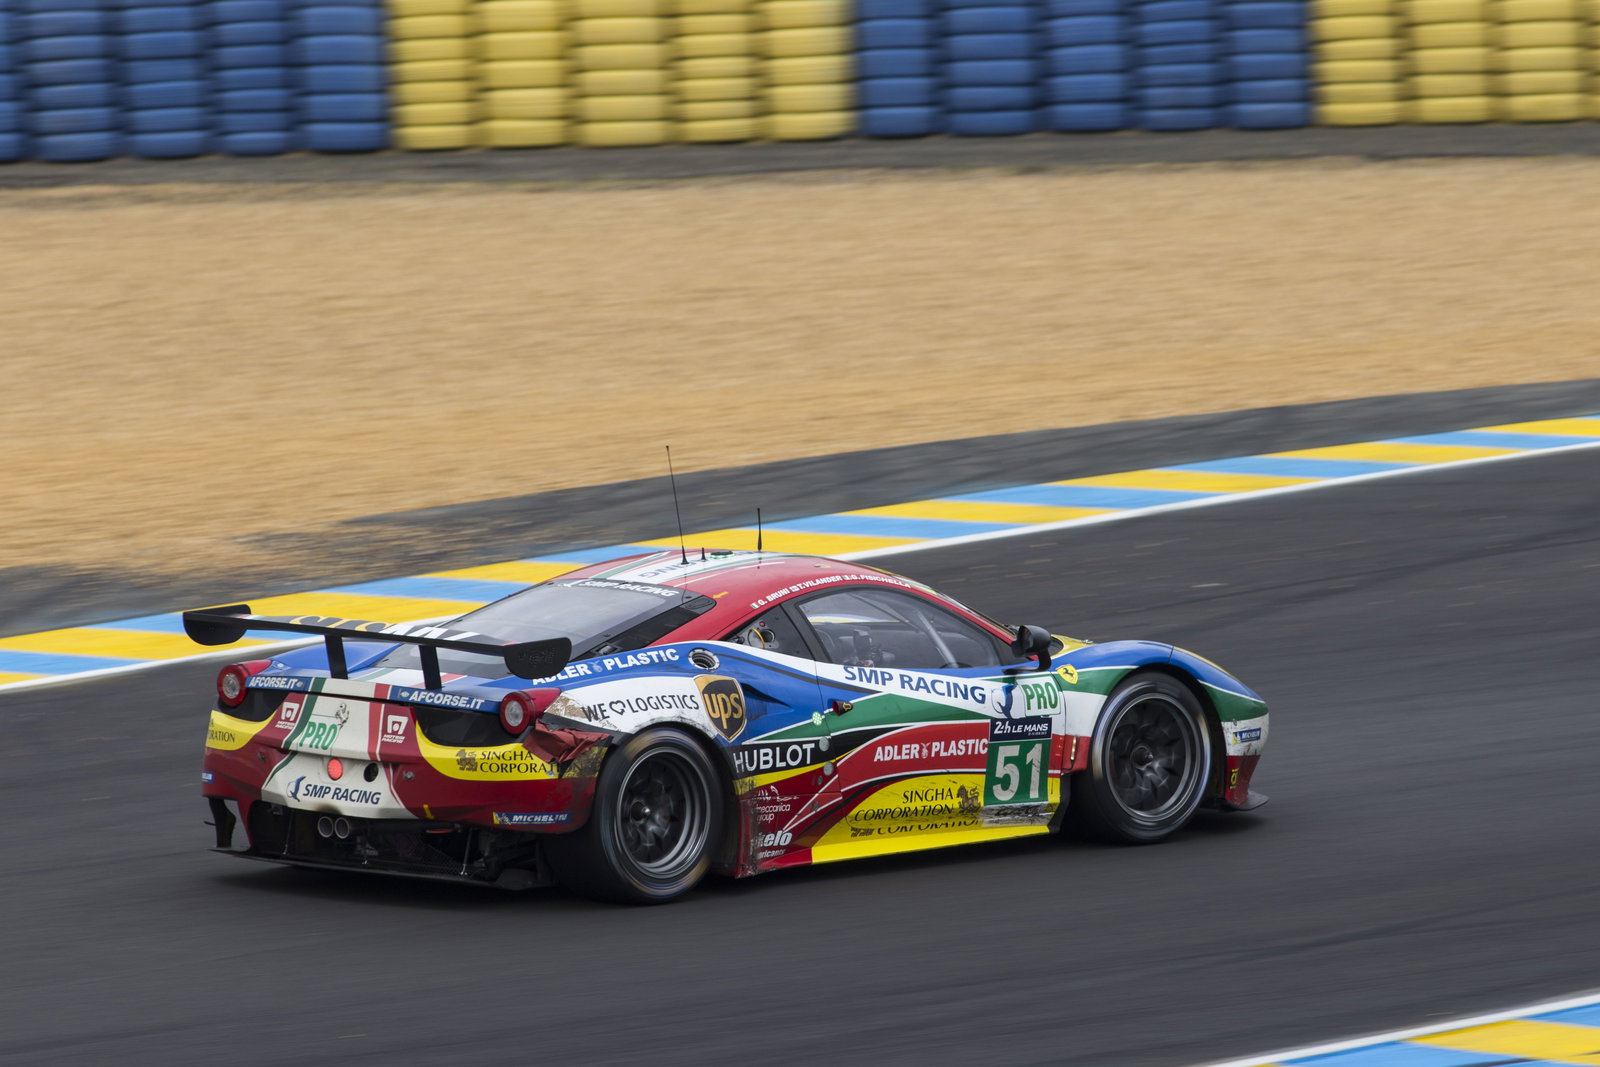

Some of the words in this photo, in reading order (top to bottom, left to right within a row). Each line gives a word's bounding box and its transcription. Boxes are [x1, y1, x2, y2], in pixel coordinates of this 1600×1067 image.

[766, 588, 791, 602] BRUNI
[532, 663, 592, 686] LER
[604, 648, 680, 671] PLASTIC
[249, 676, 297, 689] AFCORSE.IT
[843, 665, 894, 687] SMP
[899, 673, 987, 705] RACING
[409, 690, 485, 710] AFCORSE.IT
[1025, 681, 1058, 711] PRO
[582, 703, 610, 722] WE
[626, 694, 700, 713] LOGISTICS
[704, 692, 744, 730] ups
[208, 729, 235, 743] RATION
[299, 721, 338, 750] PRO
[1012, 724, 1023, 733] LE
[1024, 723, 1049, 733] MANS
[480, 750, 534, 761] SINGHA
[732, 743, 815, 773] HUBLOT
[874, 743, 920, 762] ADLER
[931, 738, 989, 757] PLASTIC
[992, 743, 1043, 801] 51
[302, 783, 331, 799] SMP
[332, 787, 382, 805] RACING
[902, 787, 954, 804] SINGHA
[512, 813, 568, 822] MICHELIN
[854, 804, 954, 822] CORPORATION
